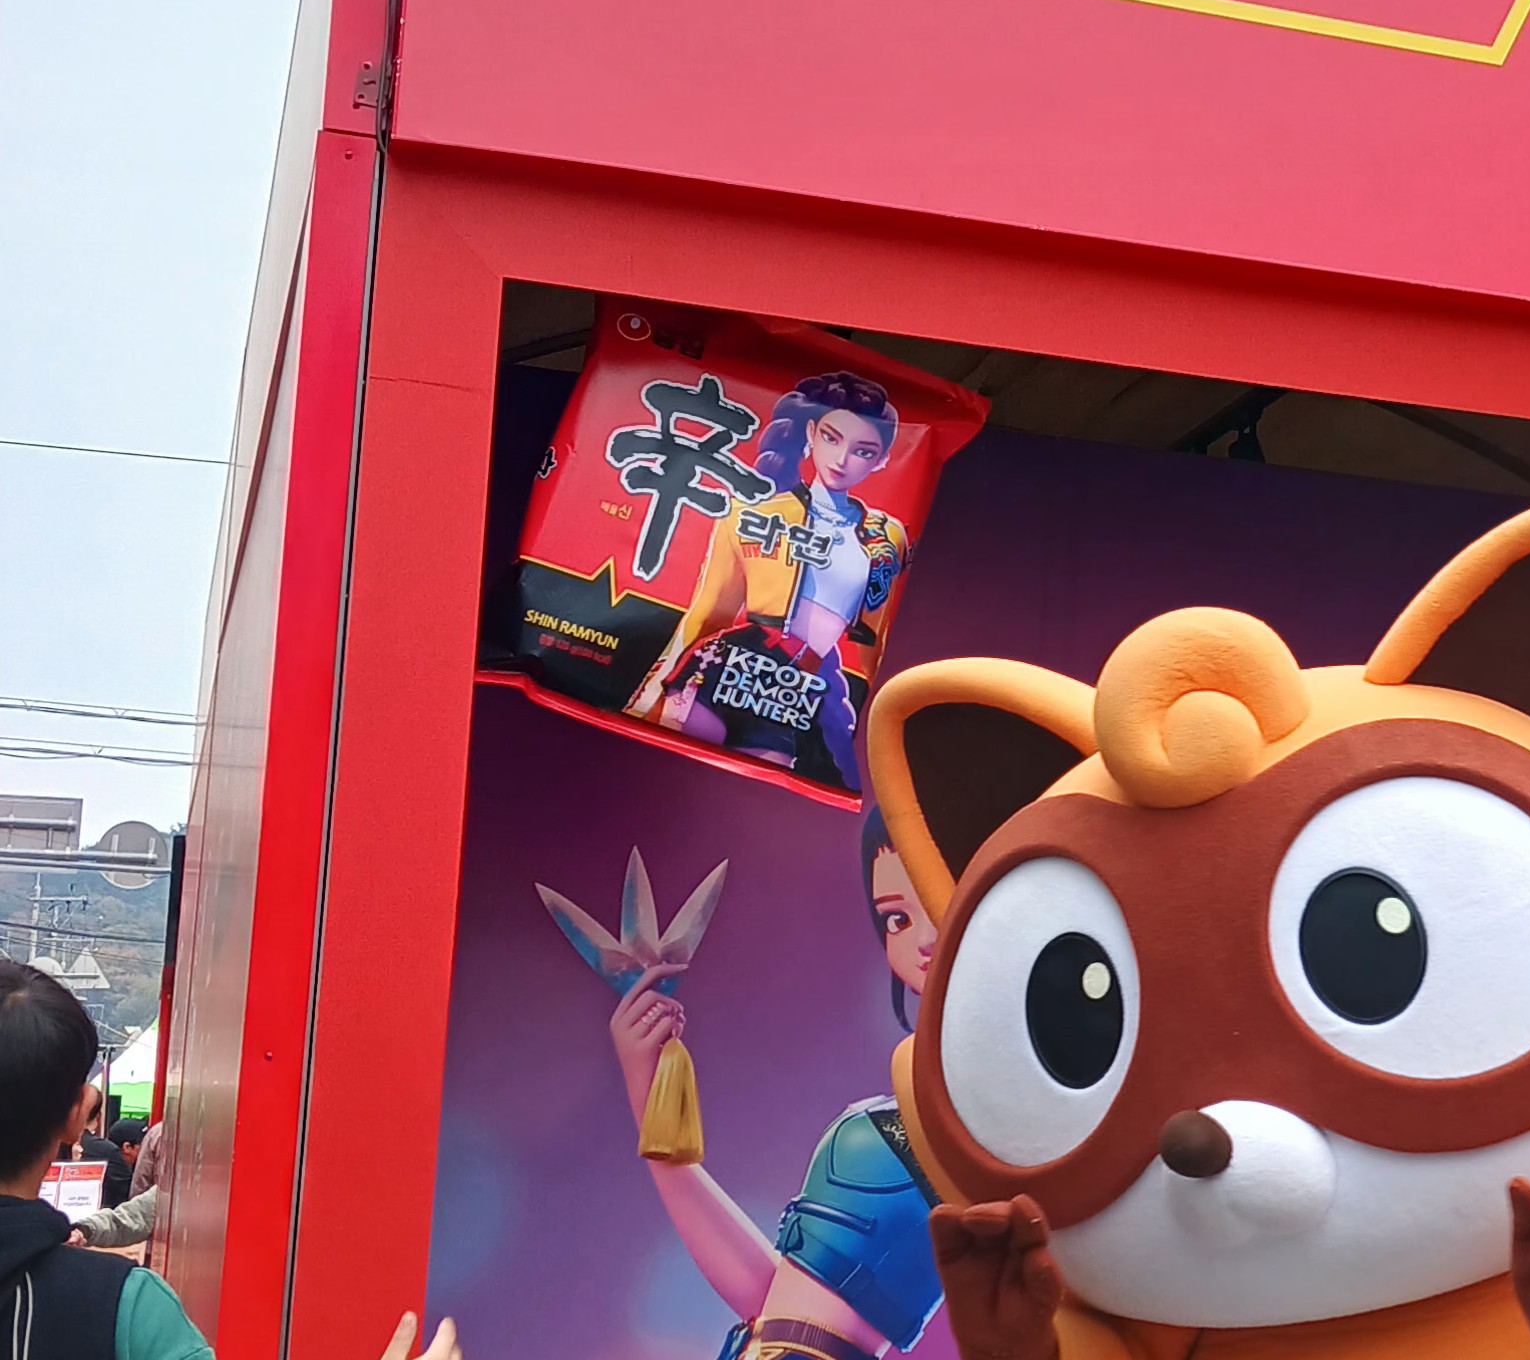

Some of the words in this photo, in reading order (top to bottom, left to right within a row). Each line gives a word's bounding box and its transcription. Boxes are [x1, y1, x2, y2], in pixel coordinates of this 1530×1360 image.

[606, 374, 775, 582] 辛
[735, 508, 832, 569] 라면
[524, 609, 559, 630] SHIN
[559, 621, 619, 650] RAMYUN
[713, 684, 811, 731] HUNTERS
[720, 666, 822, 718] DEMON
